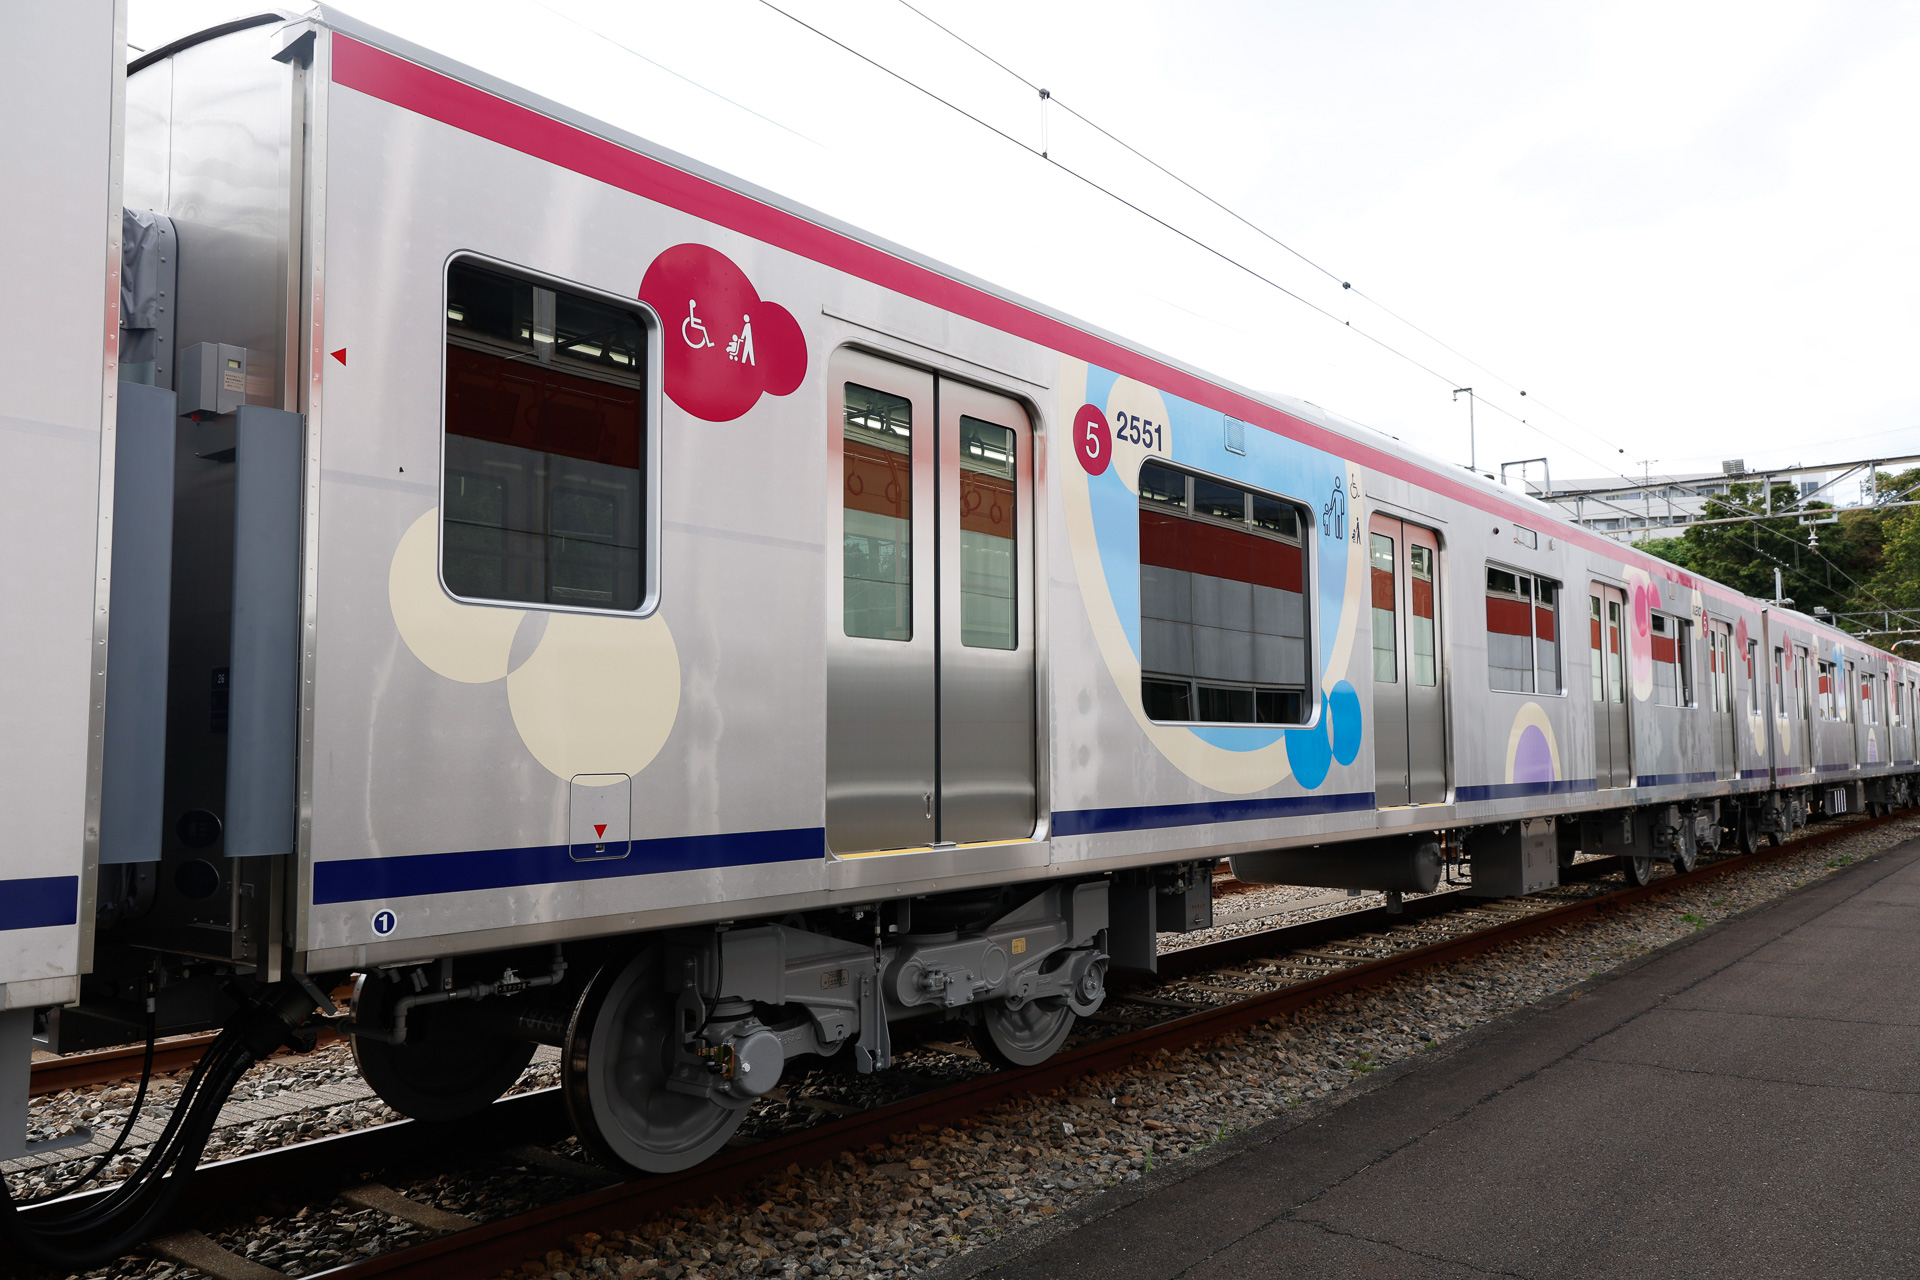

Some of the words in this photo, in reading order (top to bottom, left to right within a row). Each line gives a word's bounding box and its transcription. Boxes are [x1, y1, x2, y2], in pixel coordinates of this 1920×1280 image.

[1085, 420, 1100, 459] 5
[1116, 410, 1162, 452] 2551
[217, 673, 225, 684] 26
